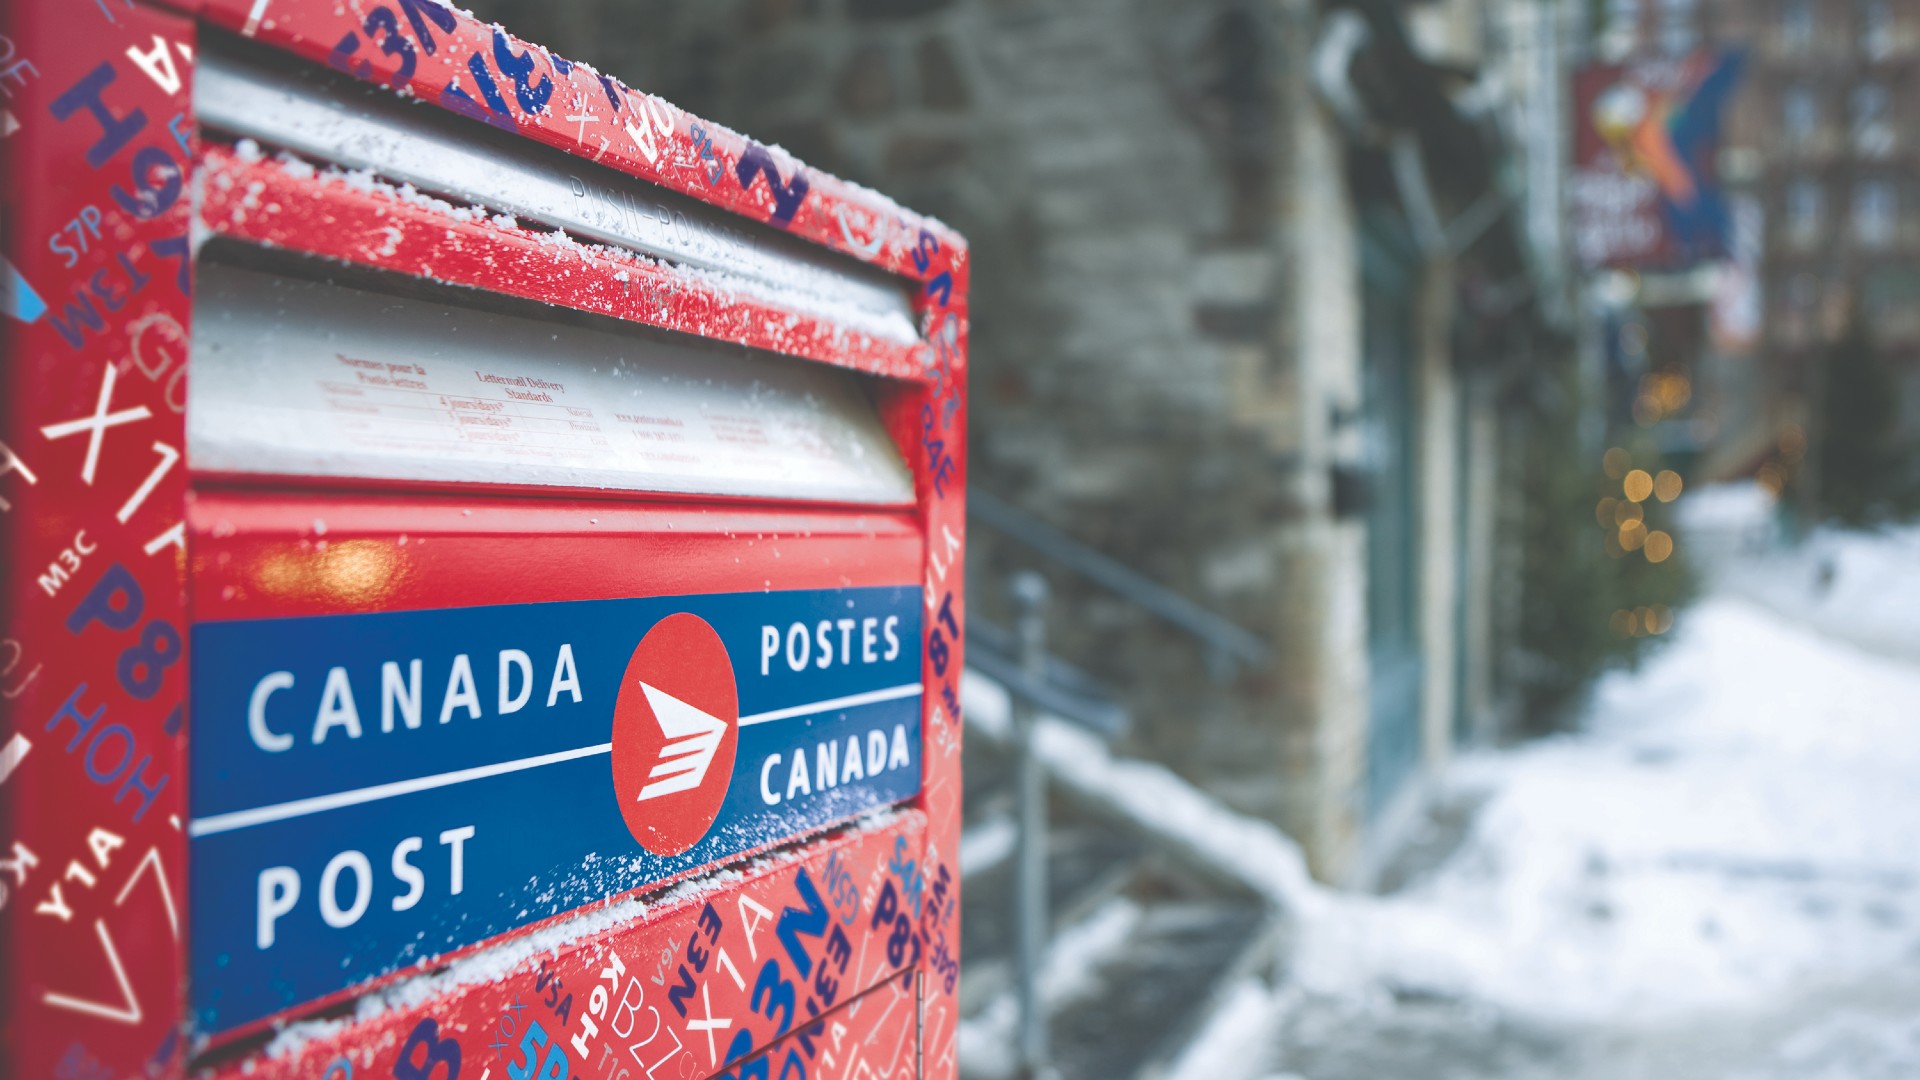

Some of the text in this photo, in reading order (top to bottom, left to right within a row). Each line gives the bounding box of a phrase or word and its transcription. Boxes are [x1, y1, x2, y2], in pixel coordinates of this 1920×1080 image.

[49, 205, 102, 269] S7P
[475, 370, 566, 394] Lettermail Delivery
[505, 387, 554, 403] Standards
[37, 528, 98, 597] M3C
[760, 615, 900, 676] POSTES
[247, 643, 583, 753] CANADA
[759, 723, 911, 806] CANADA
[34, 825, 126, 922] Y1A
[256, 825, 476, 950] POST
[667, 901, 723, 1019] E3N
[685, 892, 775, 1070] X1A
[569, 950, 627, 1061] K6H
